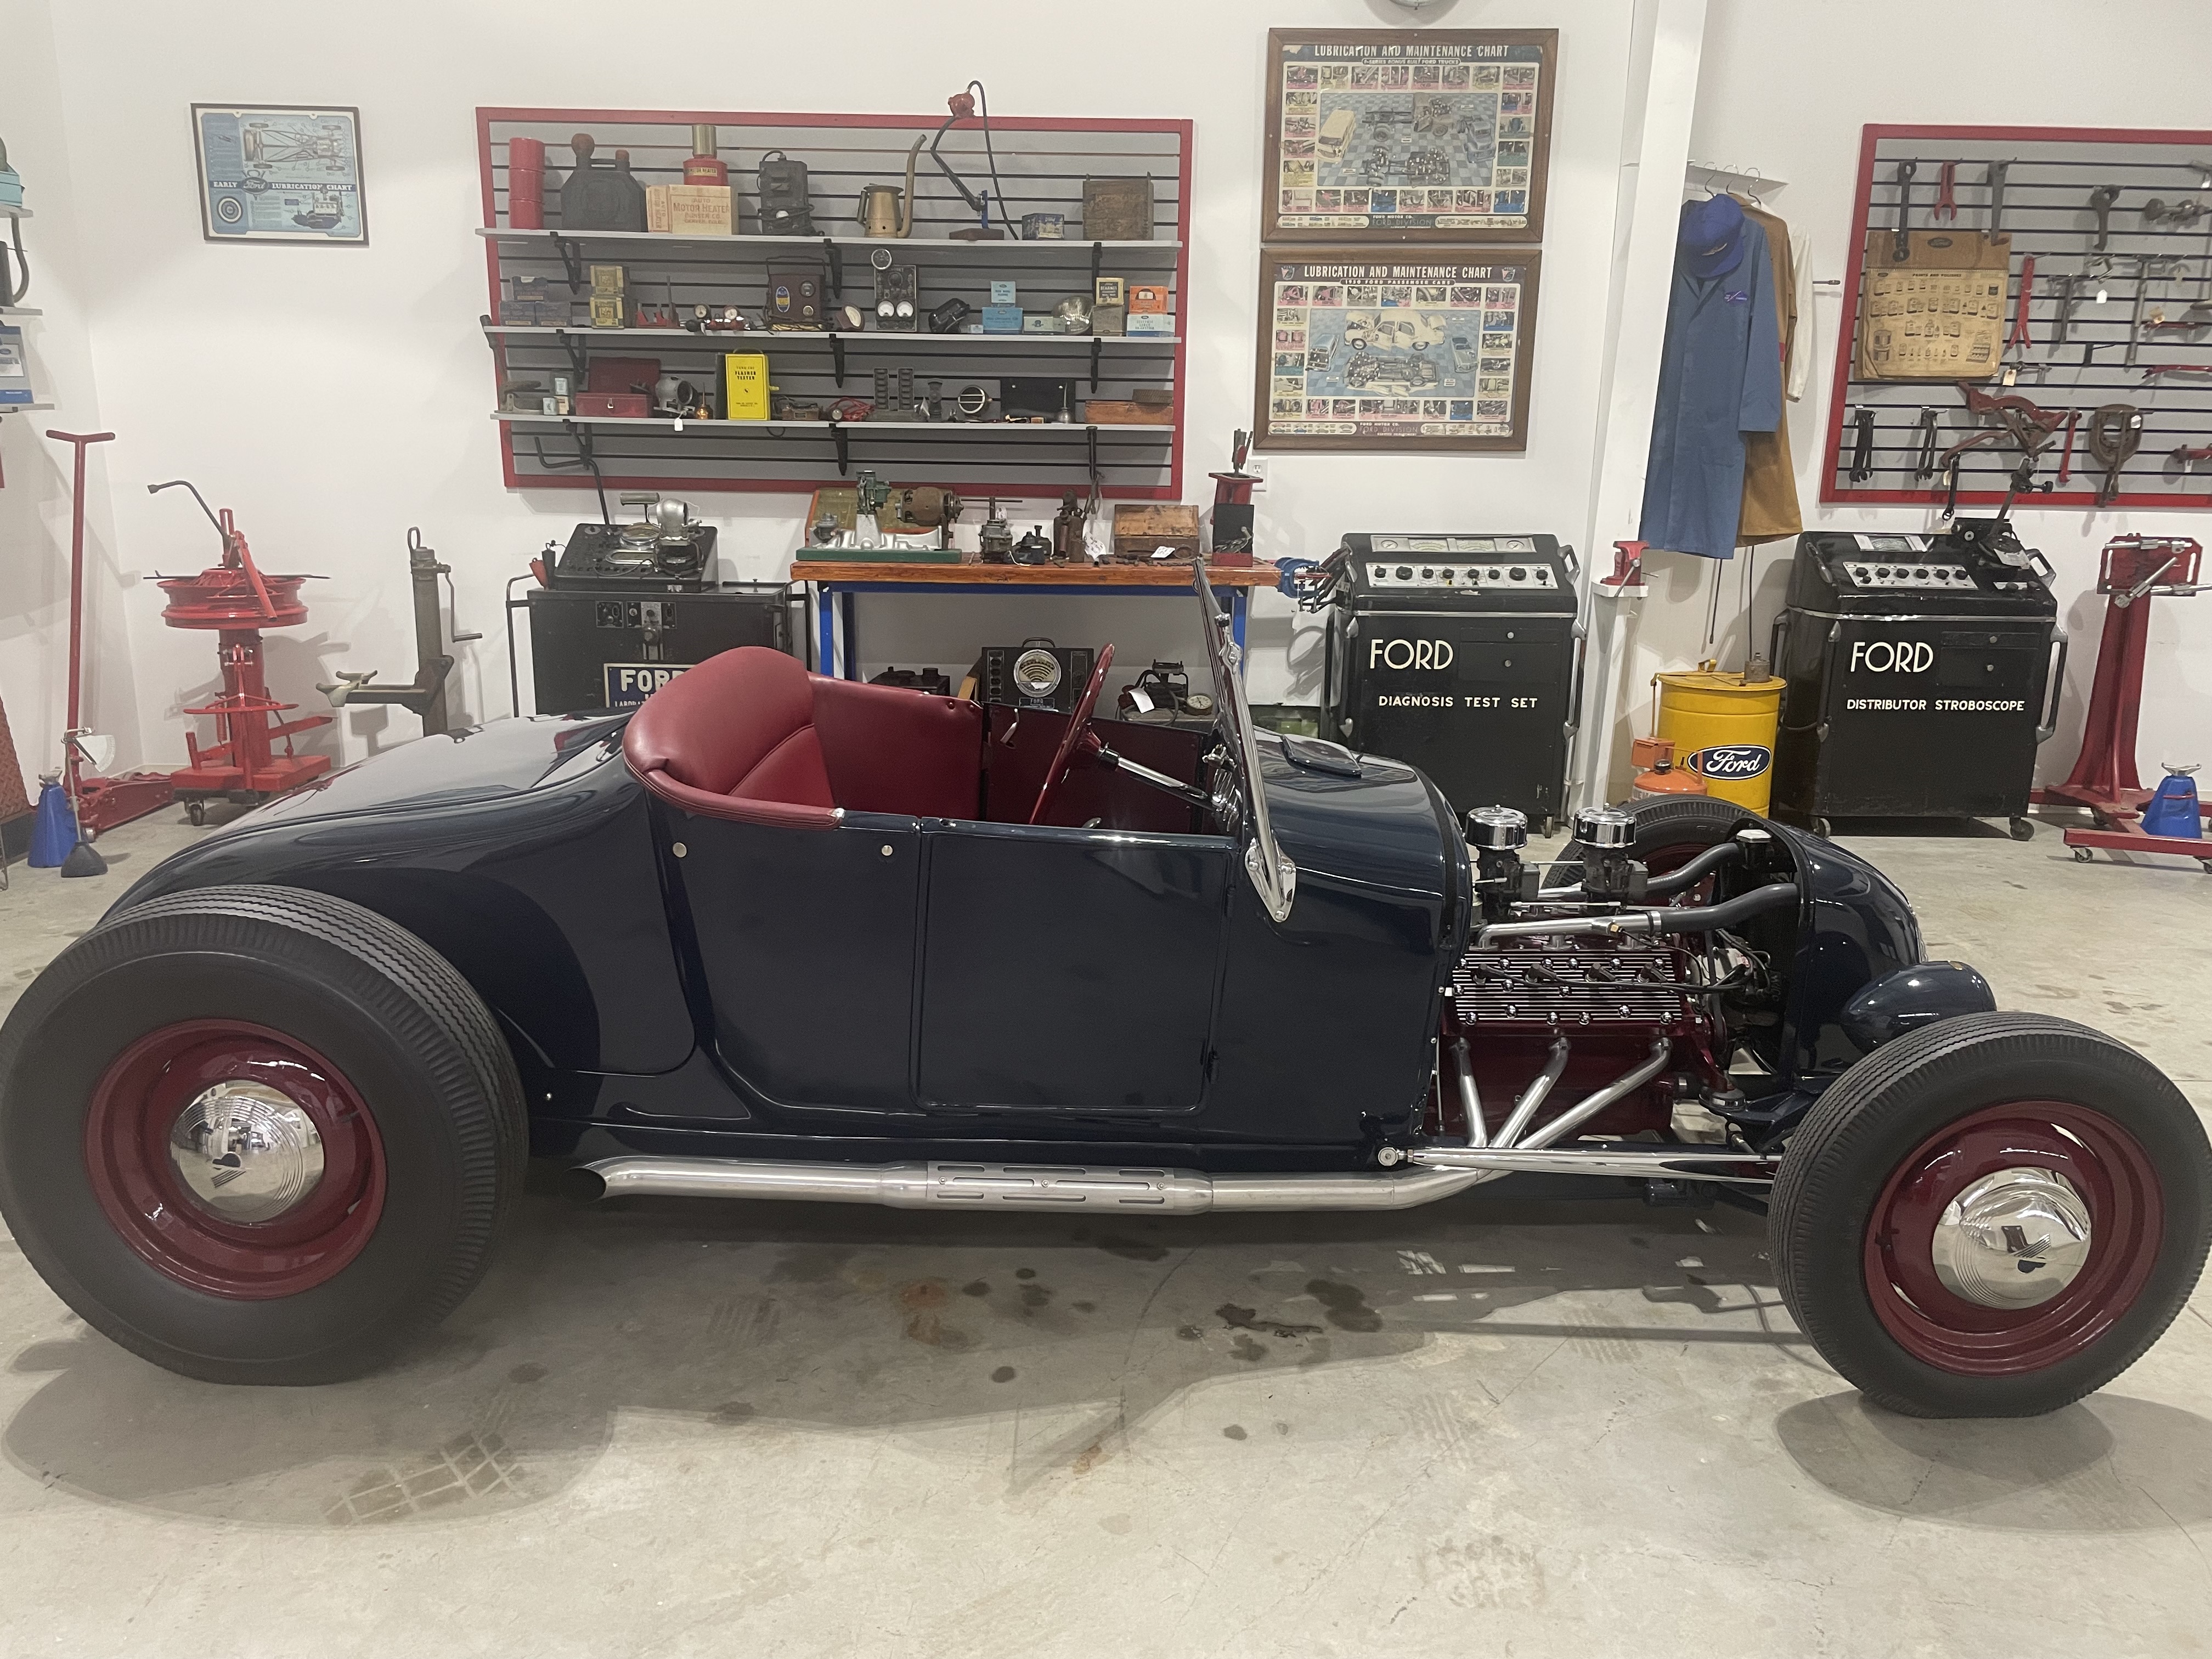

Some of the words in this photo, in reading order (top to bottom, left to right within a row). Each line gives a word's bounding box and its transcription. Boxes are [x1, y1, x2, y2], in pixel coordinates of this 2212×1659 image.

[1314, 45, 1377, 57] LUBRICATION
[1381, 46, 1401, 57] AND
[1406, 45, 1472, 57] MAINTENANCE
[1477, 45, 1509, 57] CHART
[243, 180, 265, 189] Ford
[673, 202, 699, 212] MOTOR
[702, 204, 729, 213] HEATER
[1304, 266, 1365, 278] LUBRICATION
[1369, 266, 1388, 278] AND
[1392, 266, 1457, 278] MAINTENANCE
[1462, 267, 1493, 278] CHART
[1370, 639, 1453, 670] FORD
[1850, 642, 1934, 673] FORD
[1379, 696, 1454, 707] DIAGNOSIS
[1464, 697, 1500, 708] TEST
[1510, 697, 1538, 708] SET
[1847, 698, 1927, 712] DISTRIBUTOR
[1934, 699, 2025, 712] STROBOSCOPE
[1706, 749, 1762, 772] Ford
